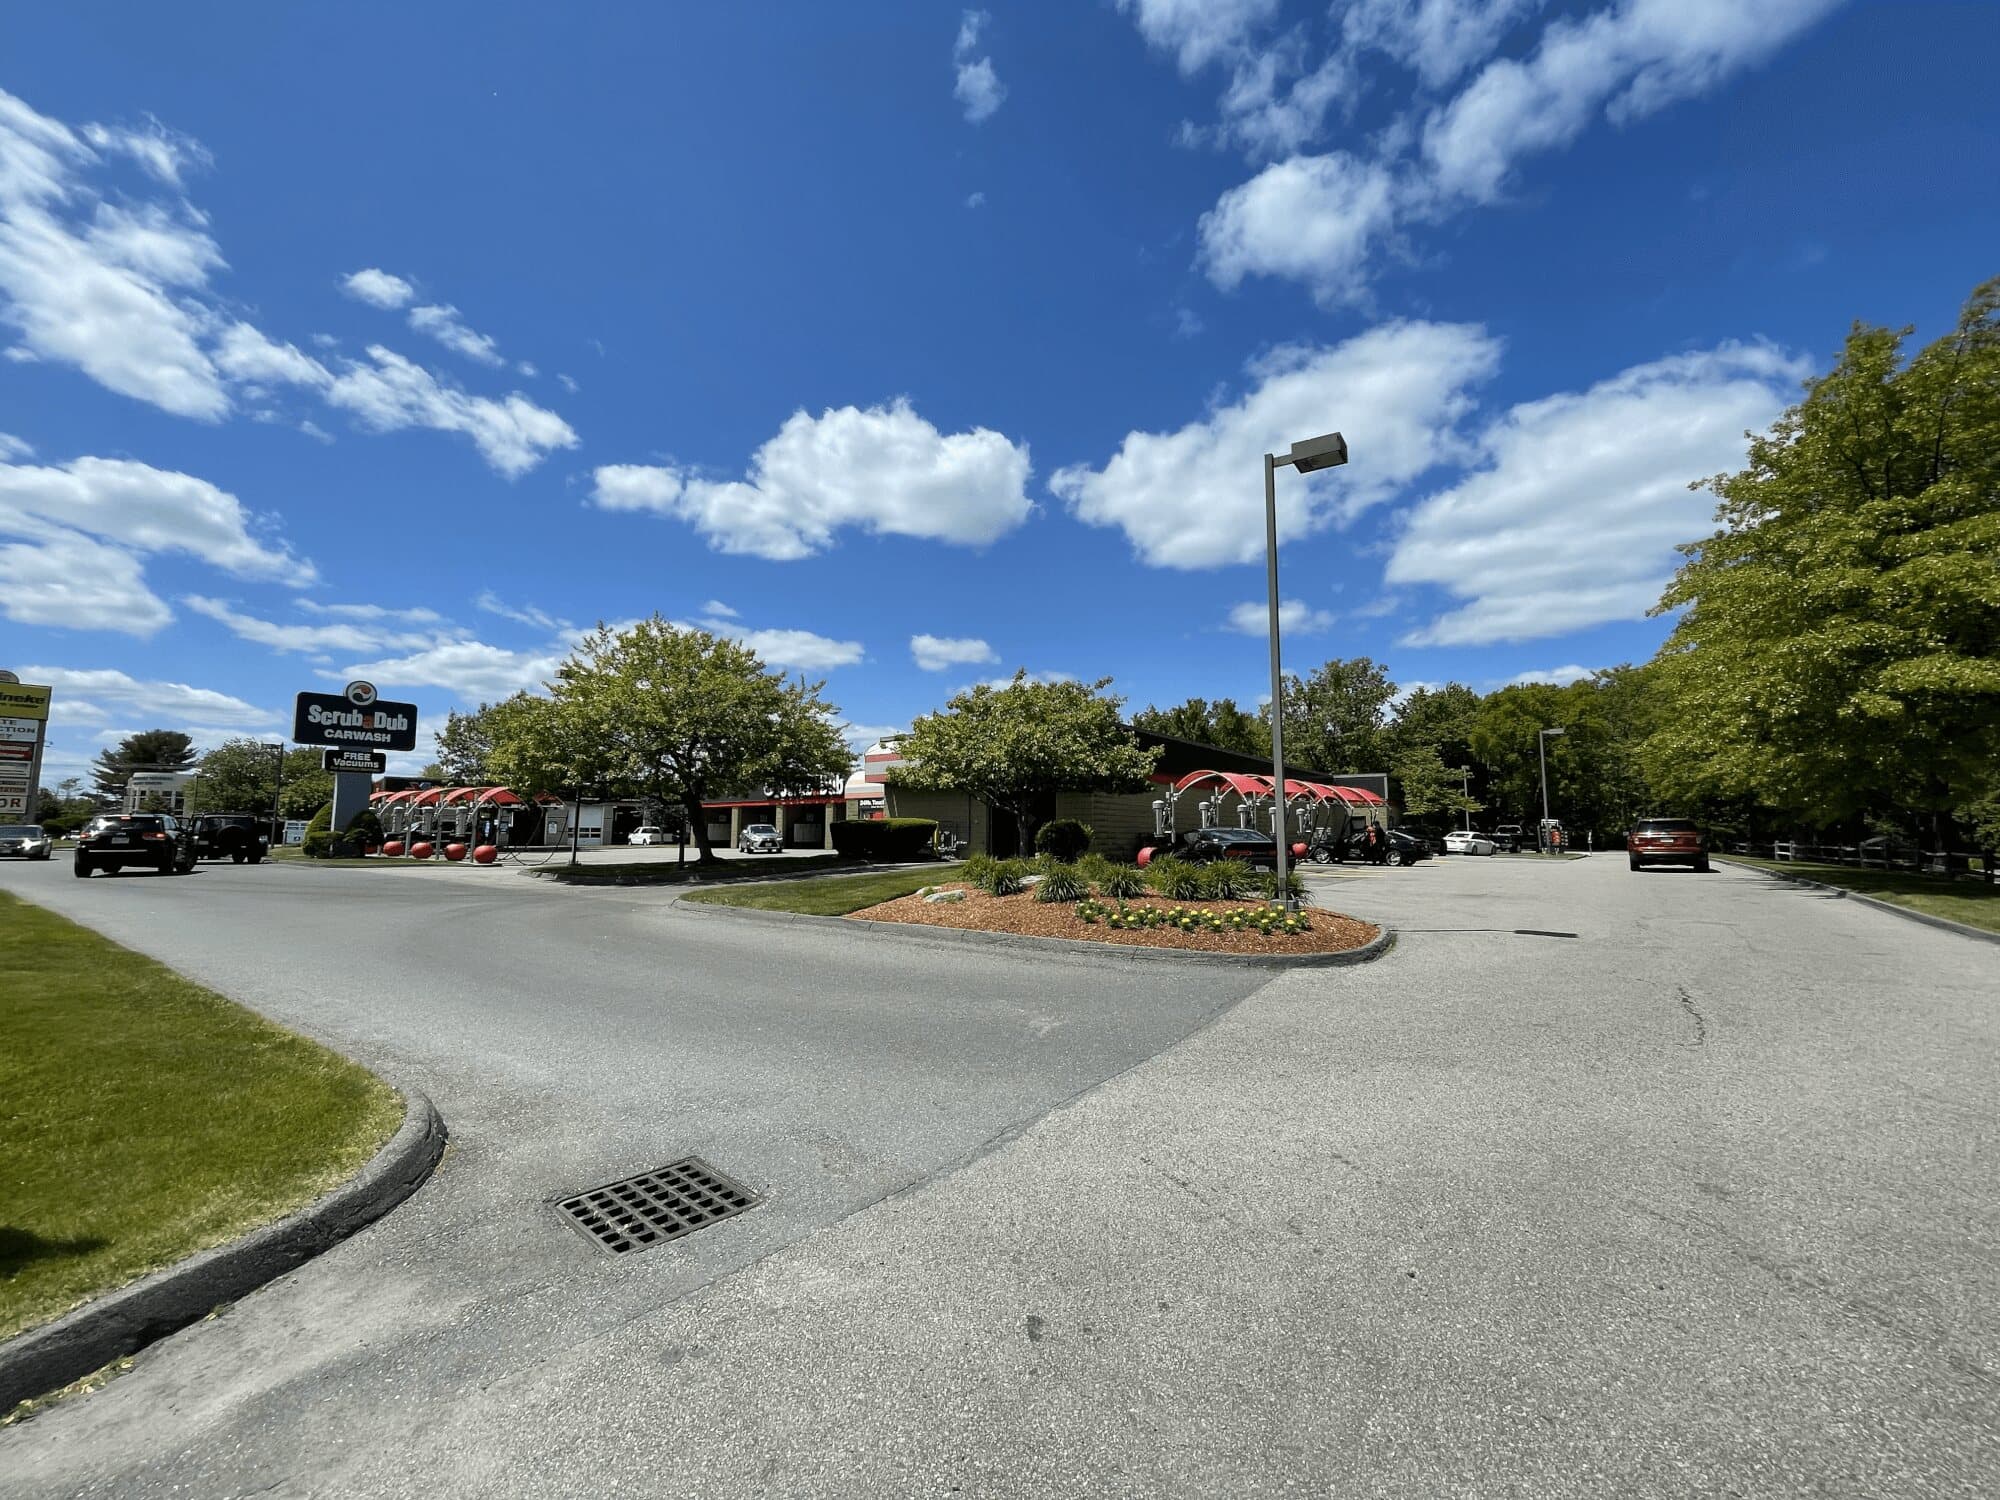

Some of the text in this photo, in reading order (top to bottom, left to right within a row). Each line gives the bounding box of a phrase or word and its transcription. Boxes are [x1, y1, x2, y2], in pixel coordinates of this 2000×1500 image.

[324, 729, 391, 742] CARWASH
[343, 752, 371, 761] FREE
[333, 758, 379, 768] Vacuums
